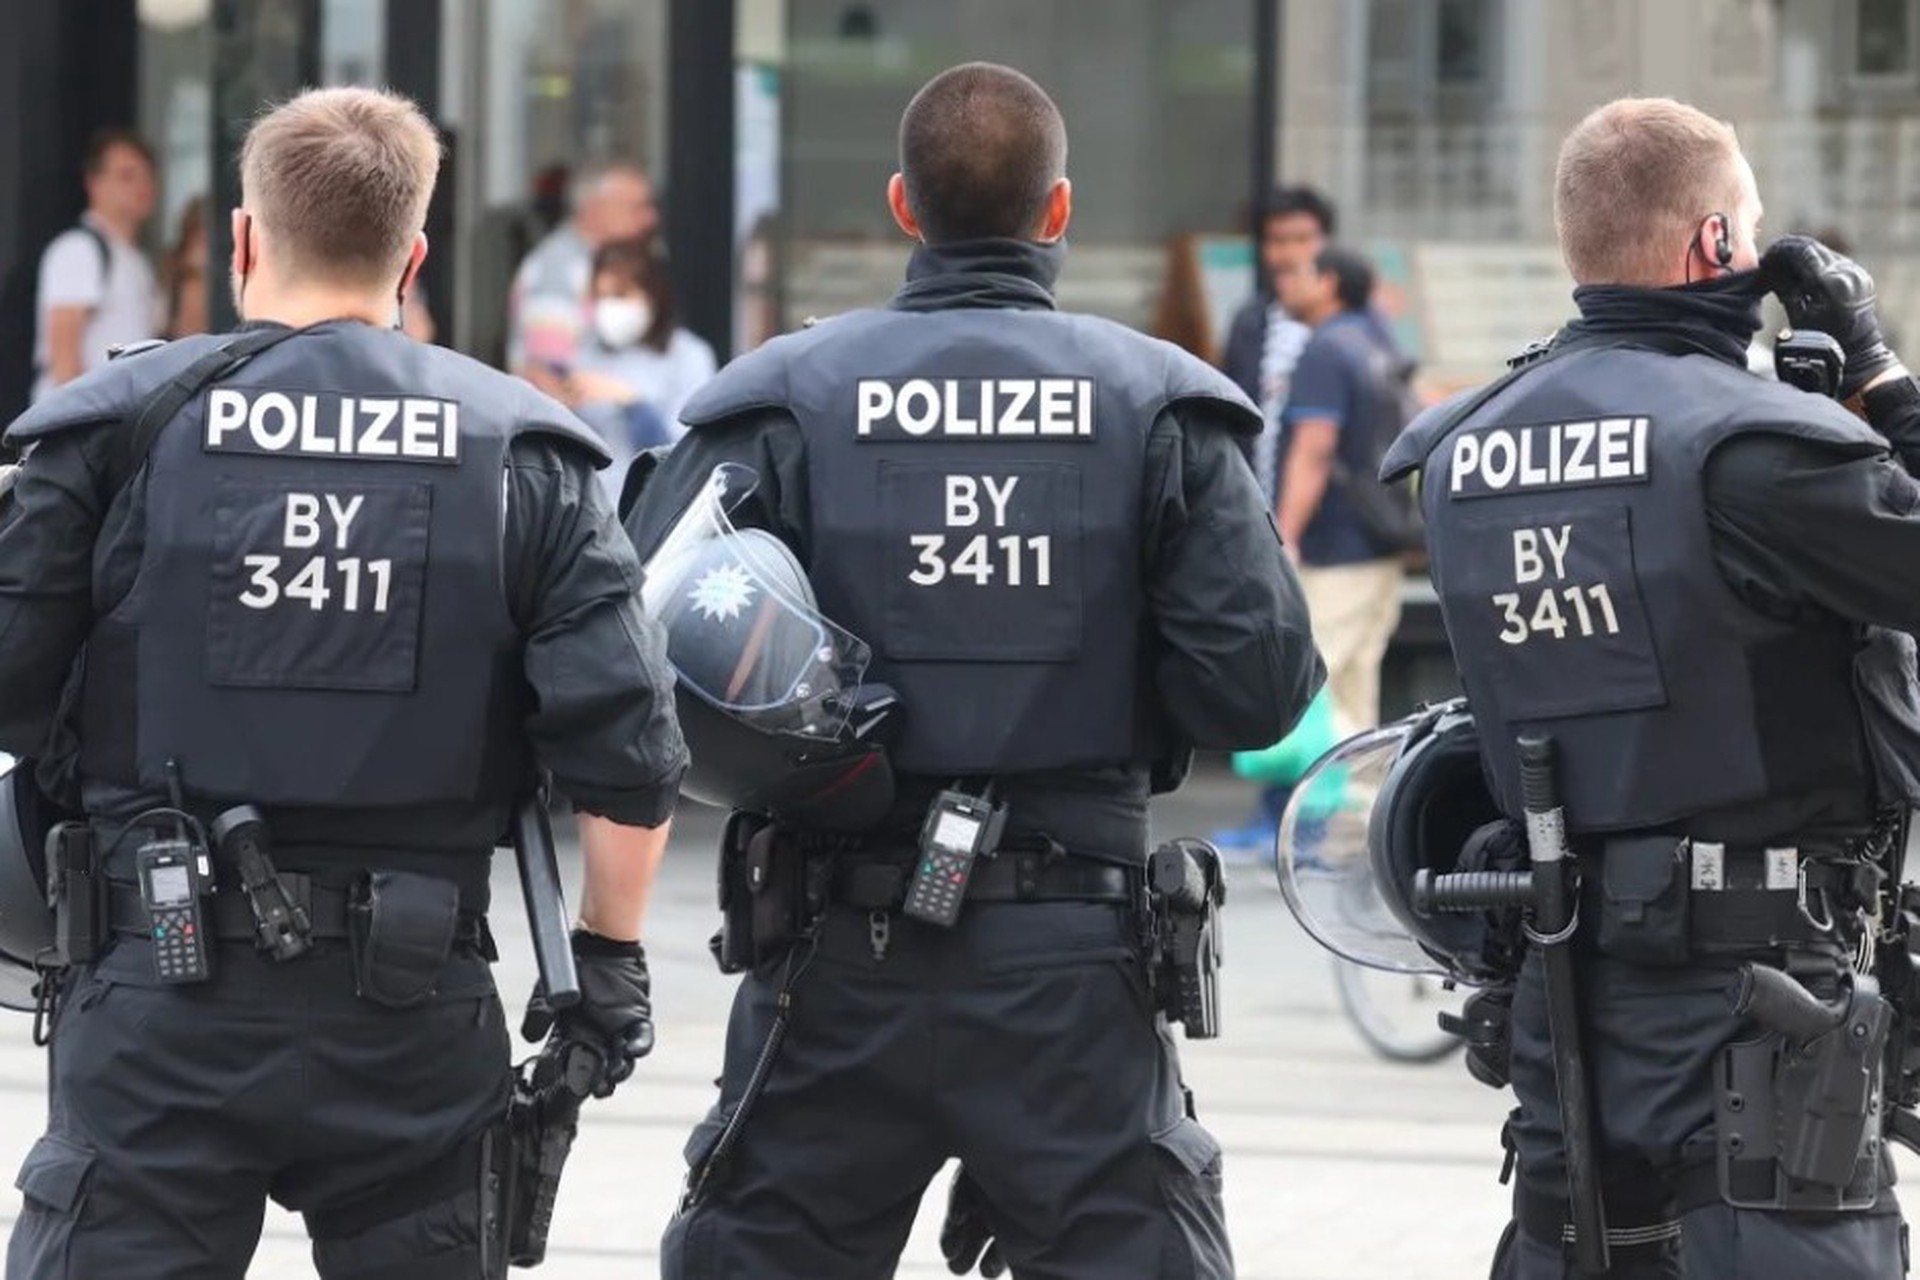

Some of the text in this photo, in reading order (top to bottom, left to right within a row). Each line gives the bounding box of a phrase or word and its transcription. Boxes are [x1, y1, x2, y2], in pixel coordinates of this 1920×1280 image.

[206, 389, 459, 458] POLIZEI
[857, 378, 1092, 436] POLIZEI
[1450, 416, 1650, 493] POLIZEI
[282, 491, 365, 549] BY
[944, 474, 1019, 528] BY
[238, 554, 392, 613] 3411
[907, 533, 1051, 587] 3411
[1512, 524, 1573, 585] BY
[1491, 584, 1620, 645] 3411
